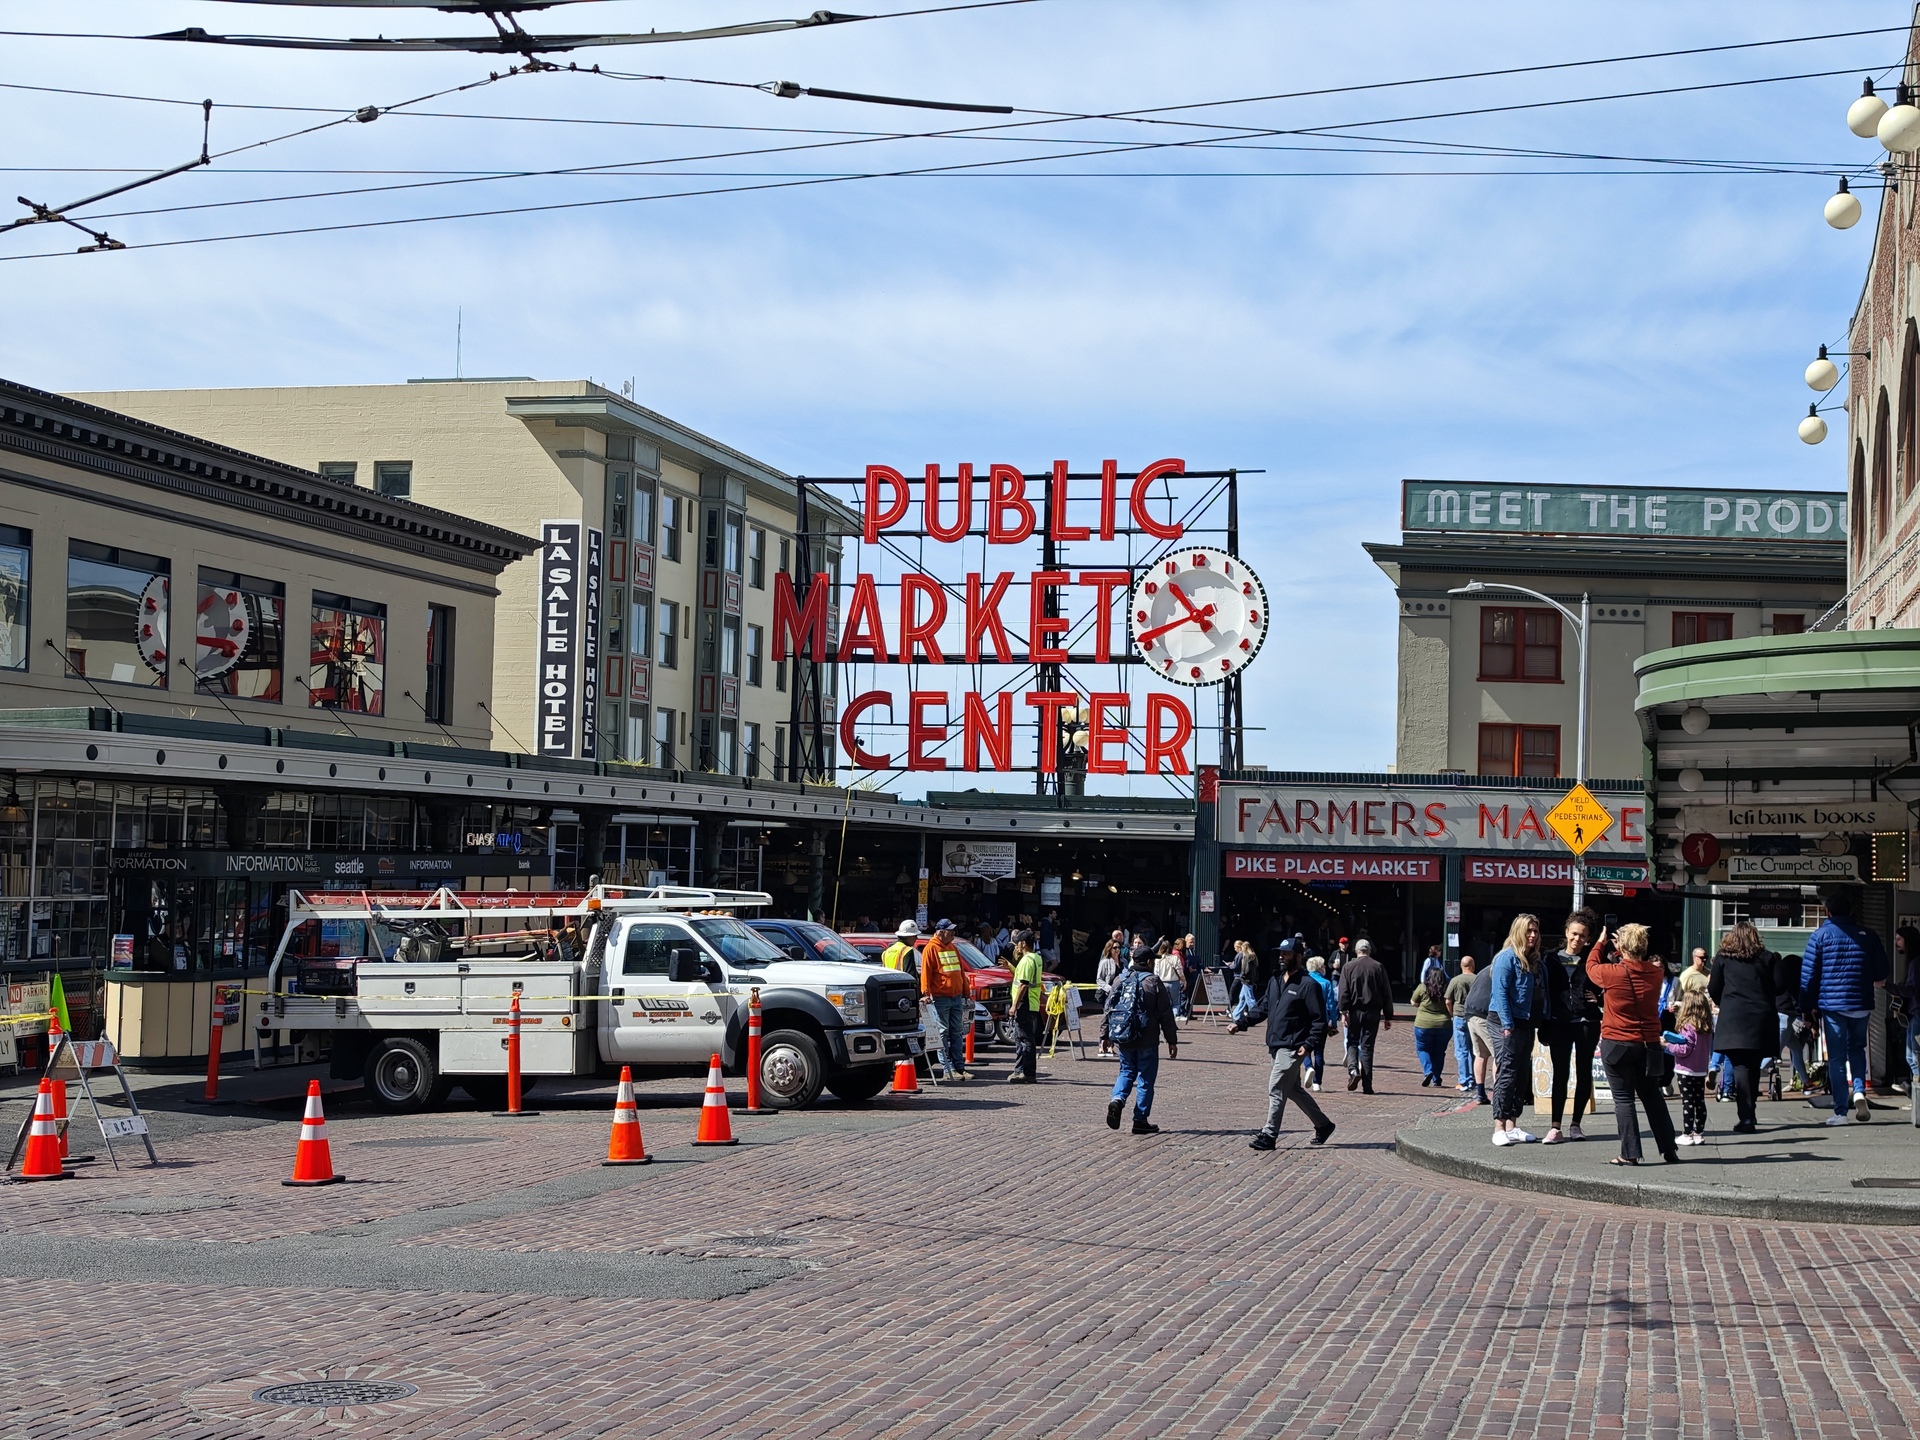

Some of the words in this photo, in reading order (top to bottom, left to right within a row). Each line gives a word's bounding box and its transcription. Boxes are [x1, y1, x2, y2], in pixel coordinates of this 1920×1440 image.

[864, 458, 1186, 544] PUBLIC
[1427, 489, 1552, 526] MEET
[1581, 493, 1667, 529] THE
[1192, 554, 1206, 566] 12
[1166, 561, 1176, 574] 11
[1144, 582, 1157, 595] 10
[1243, 582, 1251, 595] 2
[547, 568, 572, 652] SALLE
[1137, 610, 1147, 623] 9
[1249, 610, 1258, 623] 3
[771, 572, 1131, 664] MARKET
[1239, 638, 1250, 651] 4
[1164, 659, 1173, 671] 7
[1221, 659, 1230, 671] 5
[1191, 666, 1201, 678] 6
[544, 664, 567, 750] HOTEL
[583, 667, 596, 750] HOTEL
[840, 690, 1193, 775] CENTER
[1238, 798, 1447, 838] FARMERS
[1478, 802, 1644, 843] MAE
[1554, 813, 1604, 821] PEDESTRIANS
[1758, 808, 1807, 824] bank
[1814, 808, 1875, 824] books
[467, 833, 495, 846] CHASE
[496, 834, 514, 846] ATM
[226, 856, 304, 872] INFORMATION
[335, 857, 364, 874] seattle
[410, 860, 452, 870] INFORMATION
[518, 861, 530, 869] bank
[1235, 857, 1276, 873] PIKE
[1284, 858, 1345, 874] PLACE
[1352, 859, 1430, 876] MARKET
[1734, 857, 1758, 872] The
[1761, 857, 1814, 875] Crumpet
[1818, 857, 1852, 875] Shop
[1590, 867, 1612, 878] Pike
[11, 988, 20, 1001] NO
[23, 986, 48, 998] PARKING
